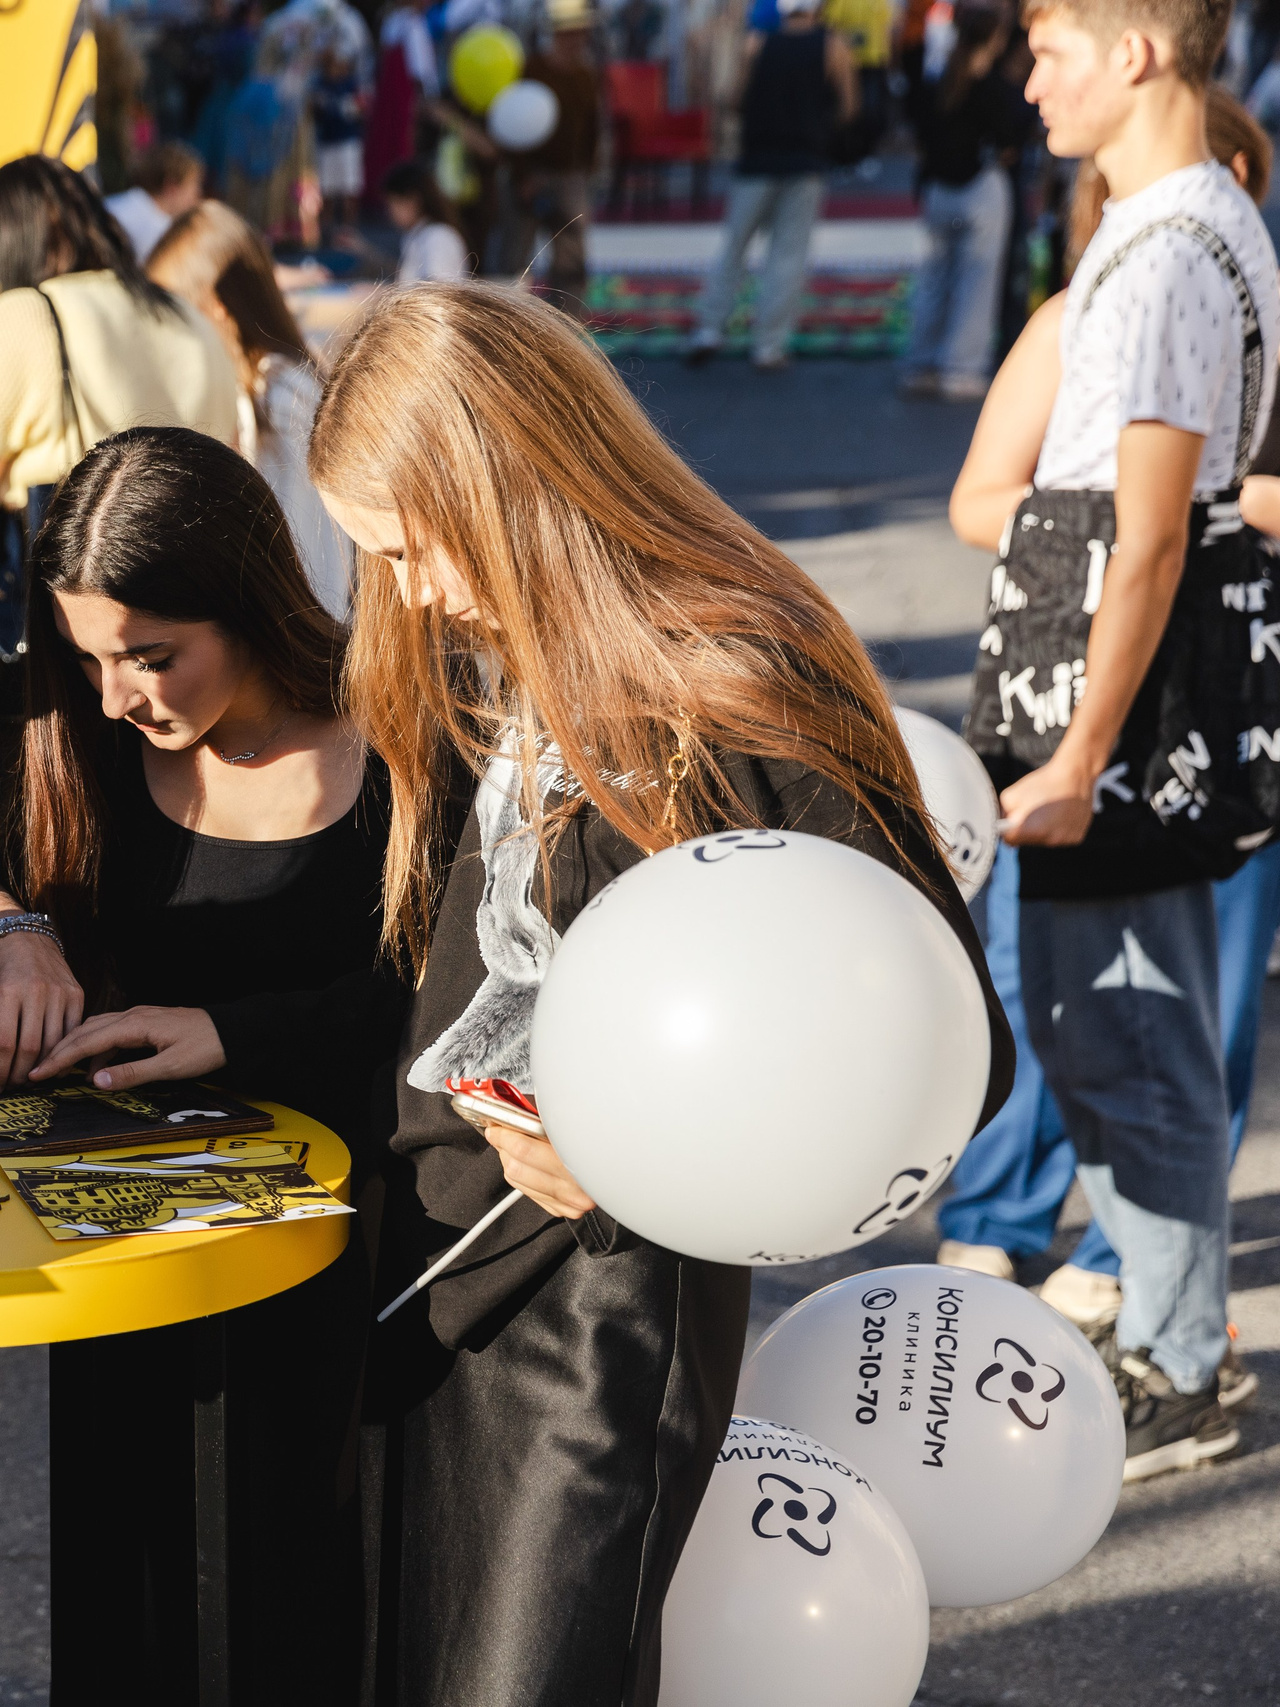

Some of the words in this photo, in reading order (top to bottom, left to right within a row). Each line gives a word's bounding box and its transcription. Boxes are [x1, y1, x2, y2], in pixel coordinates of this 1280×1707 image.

[855, 1316, 886, 1425] 20-10-70
[899, 1312, 920, 1412] клиника
[716, 1447, 873, 1493] КОНСИЛИ
[726, 1433, 823, 1451] клиник
